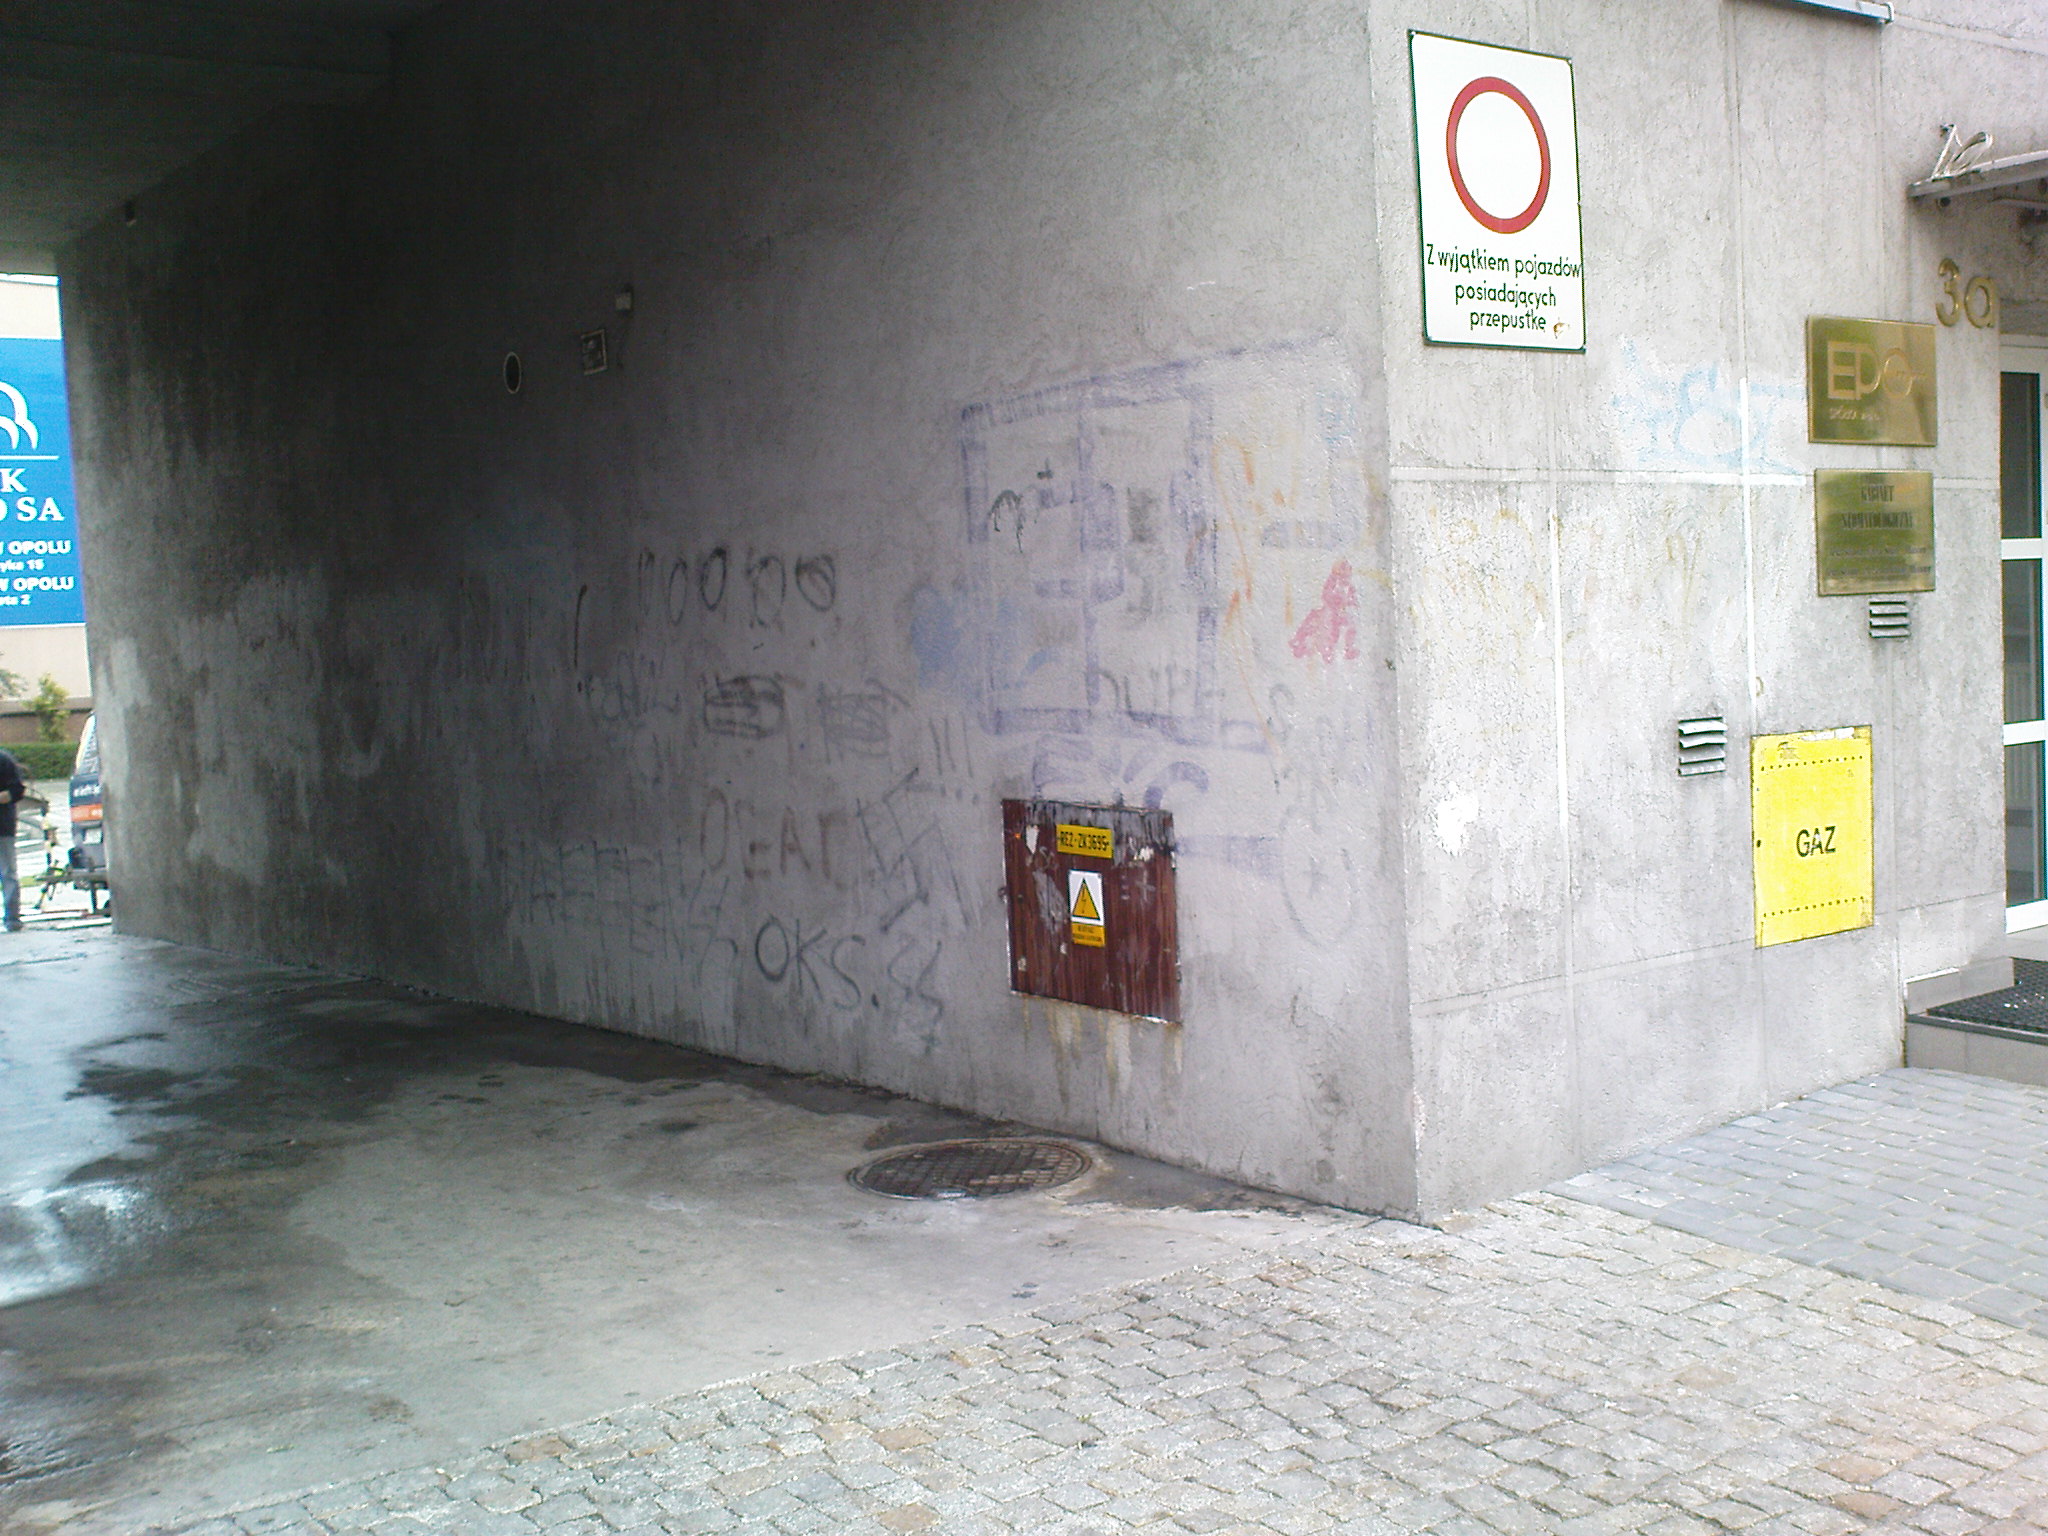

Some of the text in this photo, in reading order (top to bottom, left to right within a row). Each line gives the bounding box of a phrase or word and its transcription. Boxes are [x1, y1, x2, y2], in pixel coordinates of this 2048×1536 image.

[1426, 243, 1583, 281] Z wyjątkiem pojazdów
[1455, 280, 1557, 310] posiadających
[1936, 257, 1996, 329] 3a
[1470, 309, 1548, 333] przepustkę
[16, 496, 65, 522] SA
[8, 540, 72, 555] OPOLU
[13, 576, 75, 592] OPOLU
[20, 593, 32, 606] 2
[1795, 825, 1837, 858] GAZ
